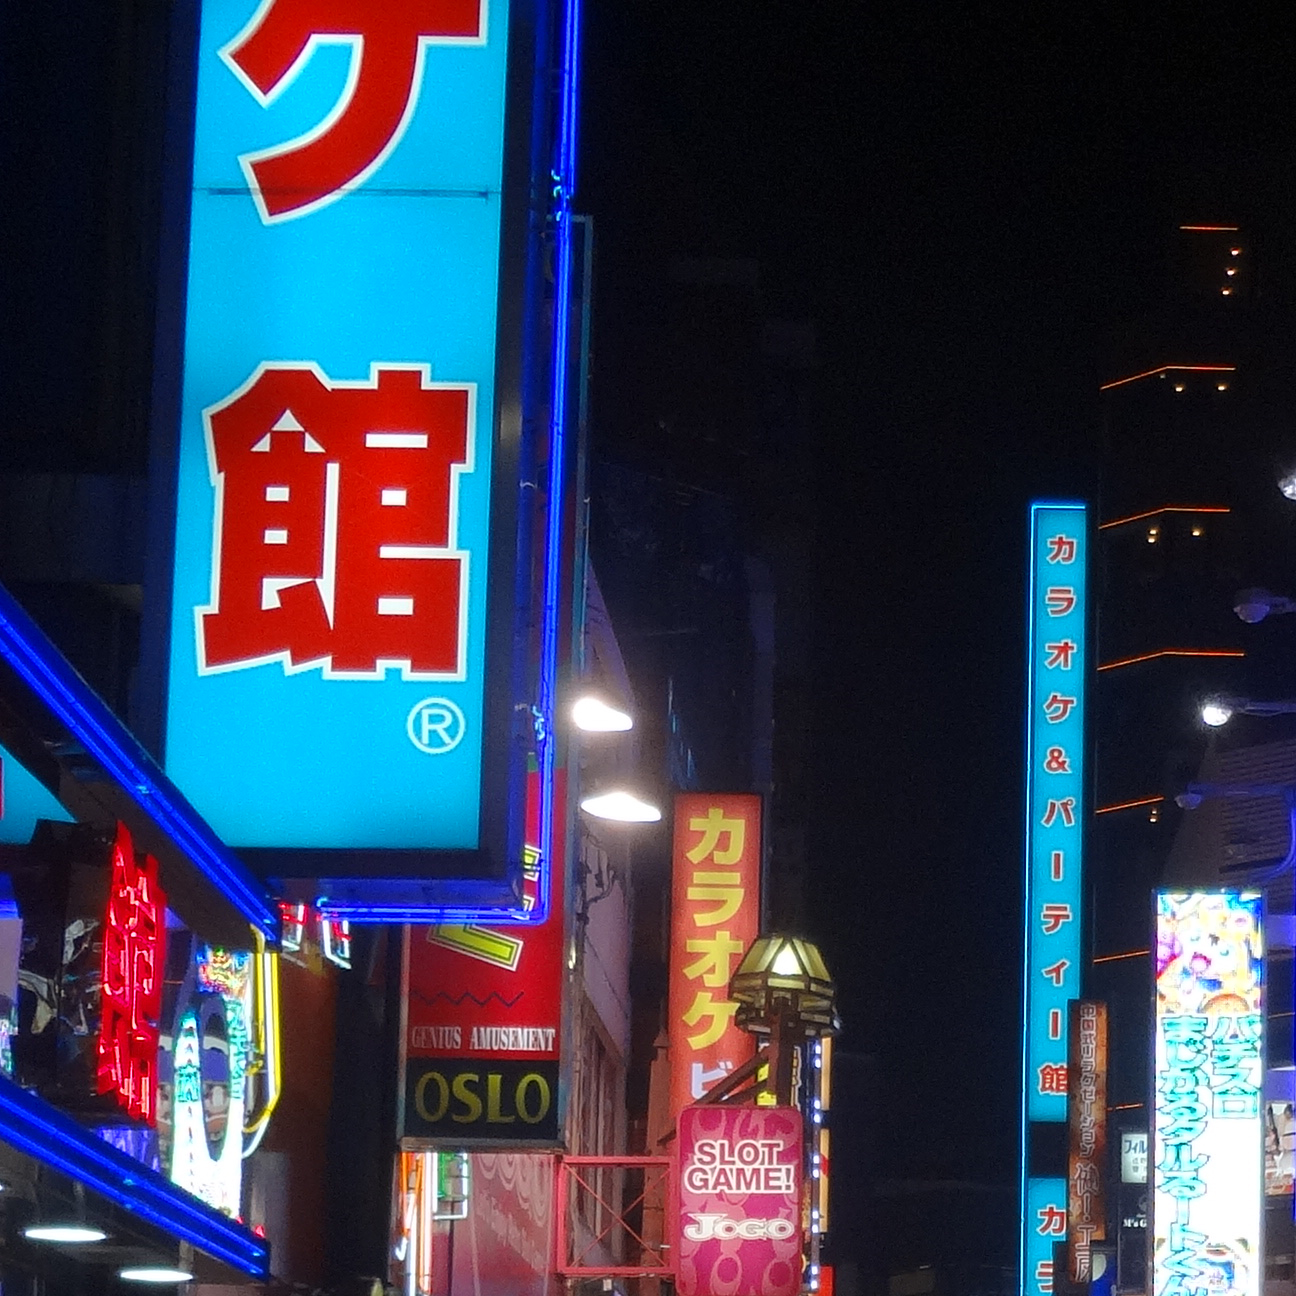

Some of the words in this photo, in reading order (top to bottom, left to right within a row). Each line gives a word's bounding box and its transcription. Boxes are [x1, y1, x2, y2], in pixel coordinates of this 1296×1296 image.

[411, 1026, 462, 1049] GENIUS
[469, 1026, 556, 1051] AMUSEMENT
[1211, 1015, 1262, 1119] パチスロ
[415, 1071, 551, 1124] OSLO
[694, 1140, 784, 1167] SLOT
[684, 1165, 795, 1194] GAME!
